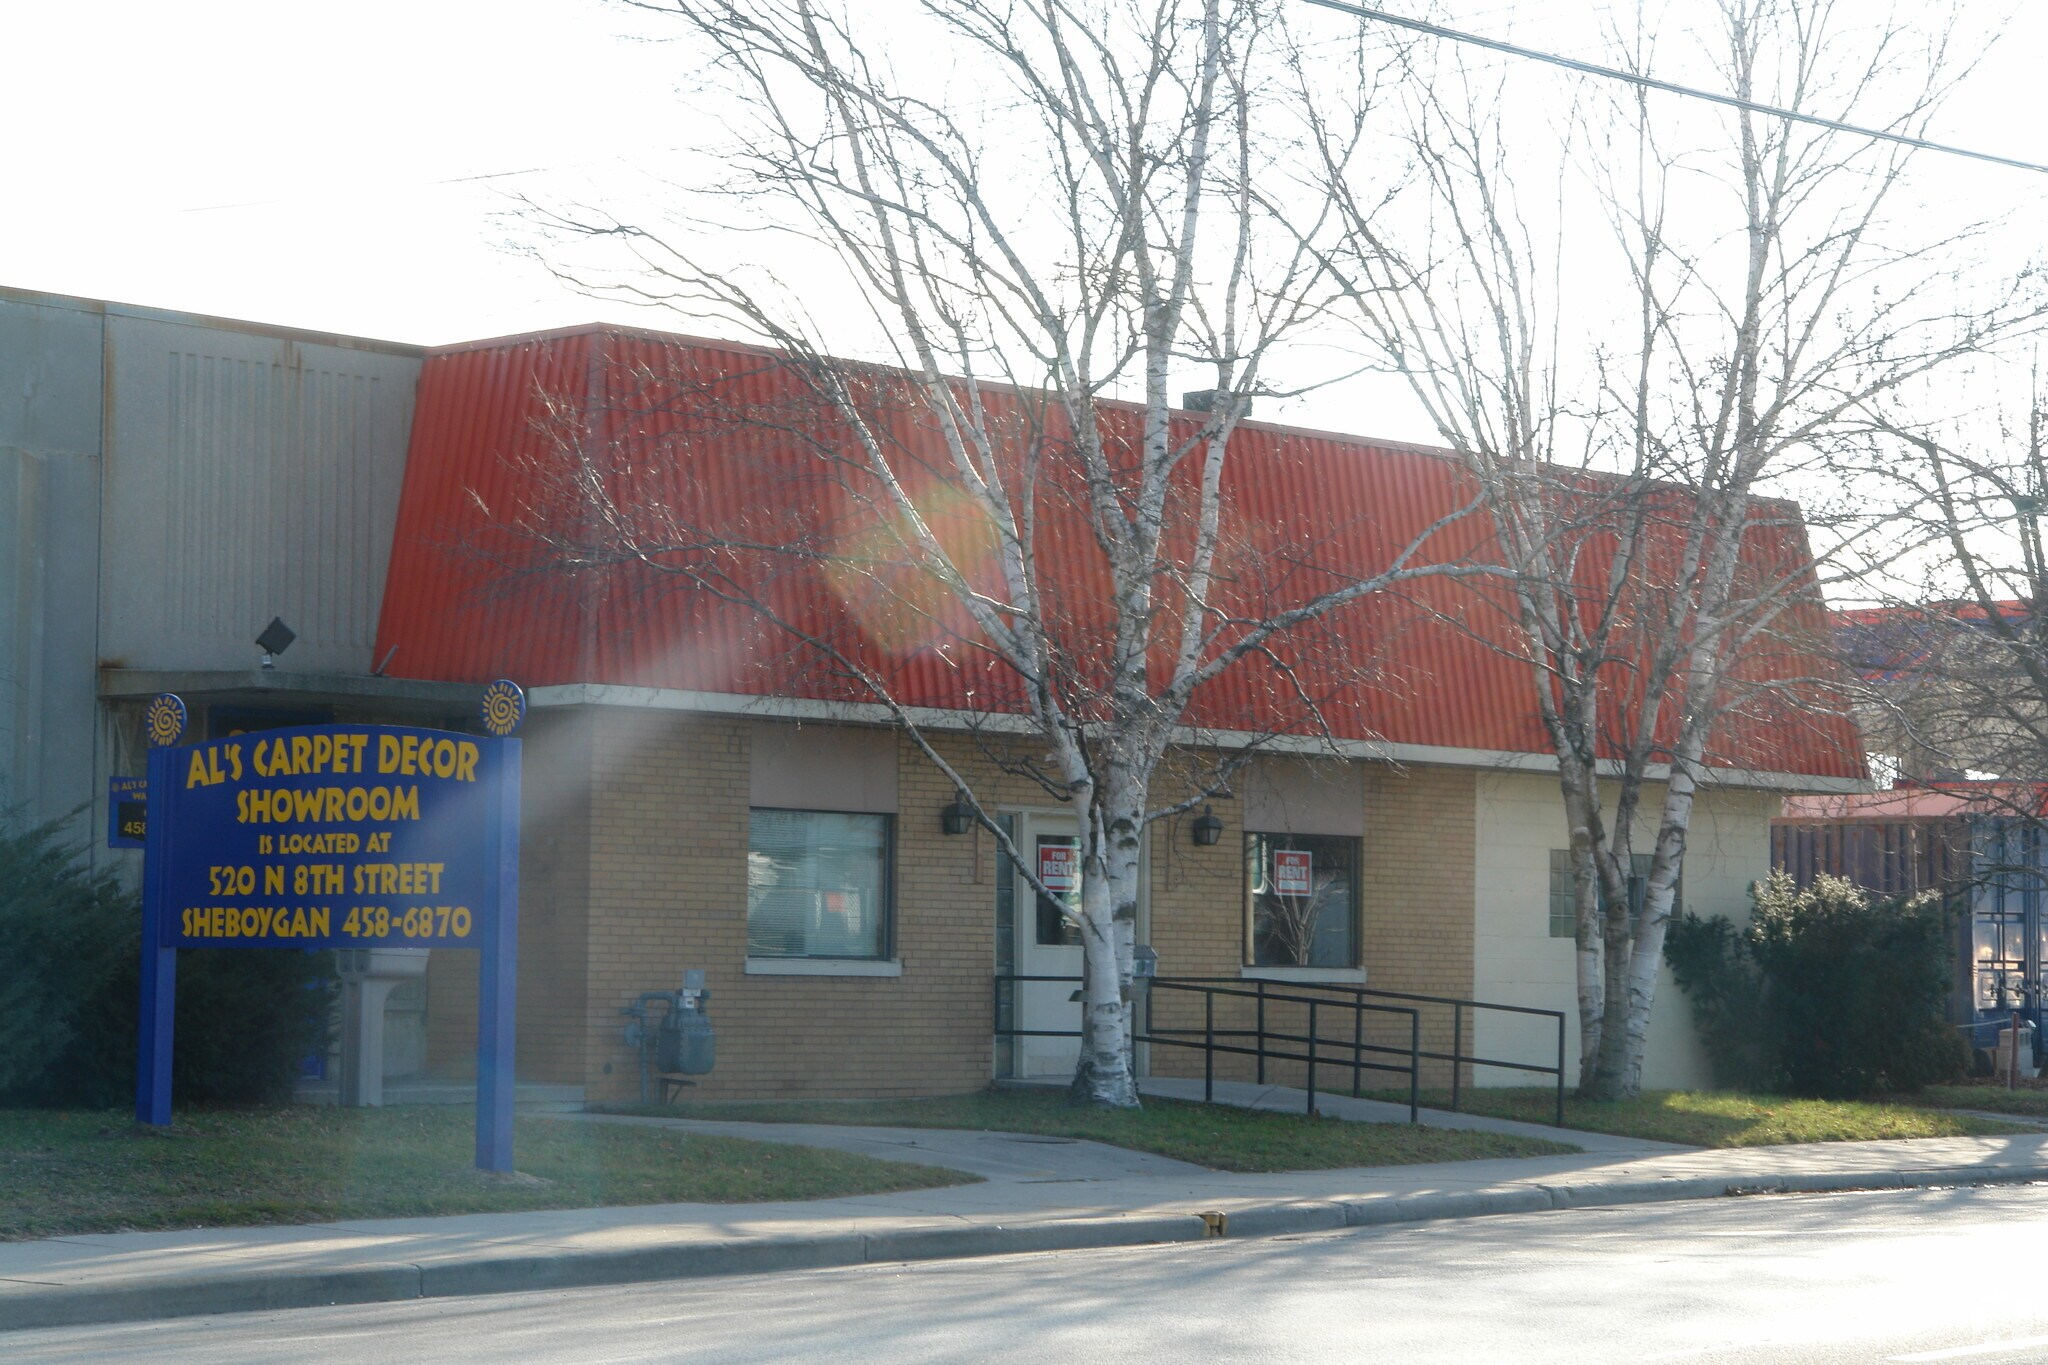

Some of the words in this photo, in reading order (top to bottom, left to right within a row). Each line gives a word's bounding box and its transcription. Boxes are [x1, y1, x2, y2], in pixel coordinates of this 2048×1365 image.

[186, 743, 242, 789] AL'S
[253, 734, 368, 777] CARPET
[378, 734, 479, 781] DECOR
[236, 785, 420, 824] SHOWROOM
[259, 834, 273, 855] IS
[279, 833, 361, 855] LOCATED
[366, 832, 392, 853] AT
[1051, 851, 1067, 860] FOR
[209, 865, 256, 896] 520
[264, 865, 285, 896] N
[294, 864, 345, 895] 8TH
[353, 863, 444, 895] STREET
[1043, 861, 1073, 875] RENT
[1278, 865, 1308, 880] RENT
[182, 907, 330, 938] SHEBOYGAN
[342, 906, 472, 938] 458-6870
